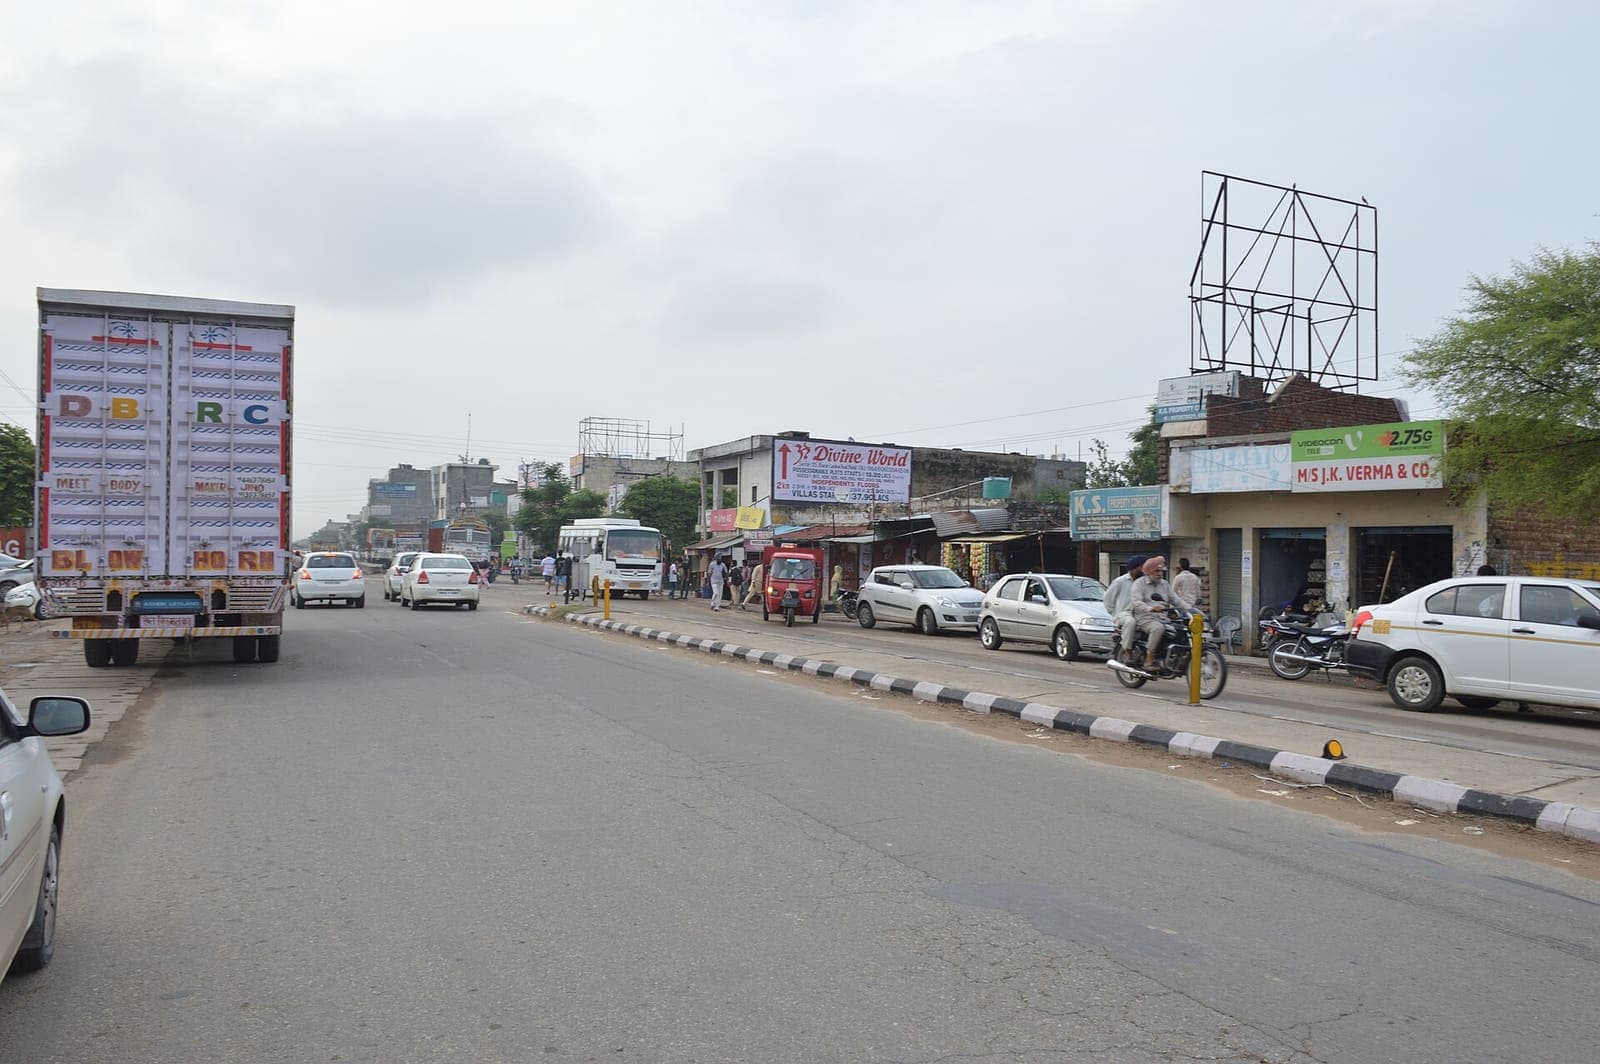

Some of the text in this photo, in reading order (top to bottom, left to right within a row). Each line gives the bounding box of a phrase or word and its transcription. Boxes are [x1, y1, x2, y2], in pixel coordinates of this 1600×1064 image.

[1297, 438, 1344, 448] VIDEOCON
[1389, 429, 1433, 446] 2.75G
[813, 445, 910, 467] Divine World
[1346, 464, 1394, 481] VERMA
[1398, 463, 1408, 479] &
[56, 477, 227, 493] MEET BODY MAKER
[857, 481, 880, 489] FLOORS
[792, 489, 817, 498] VILLAS
[1073, 495, 1107, 514] K.S.
